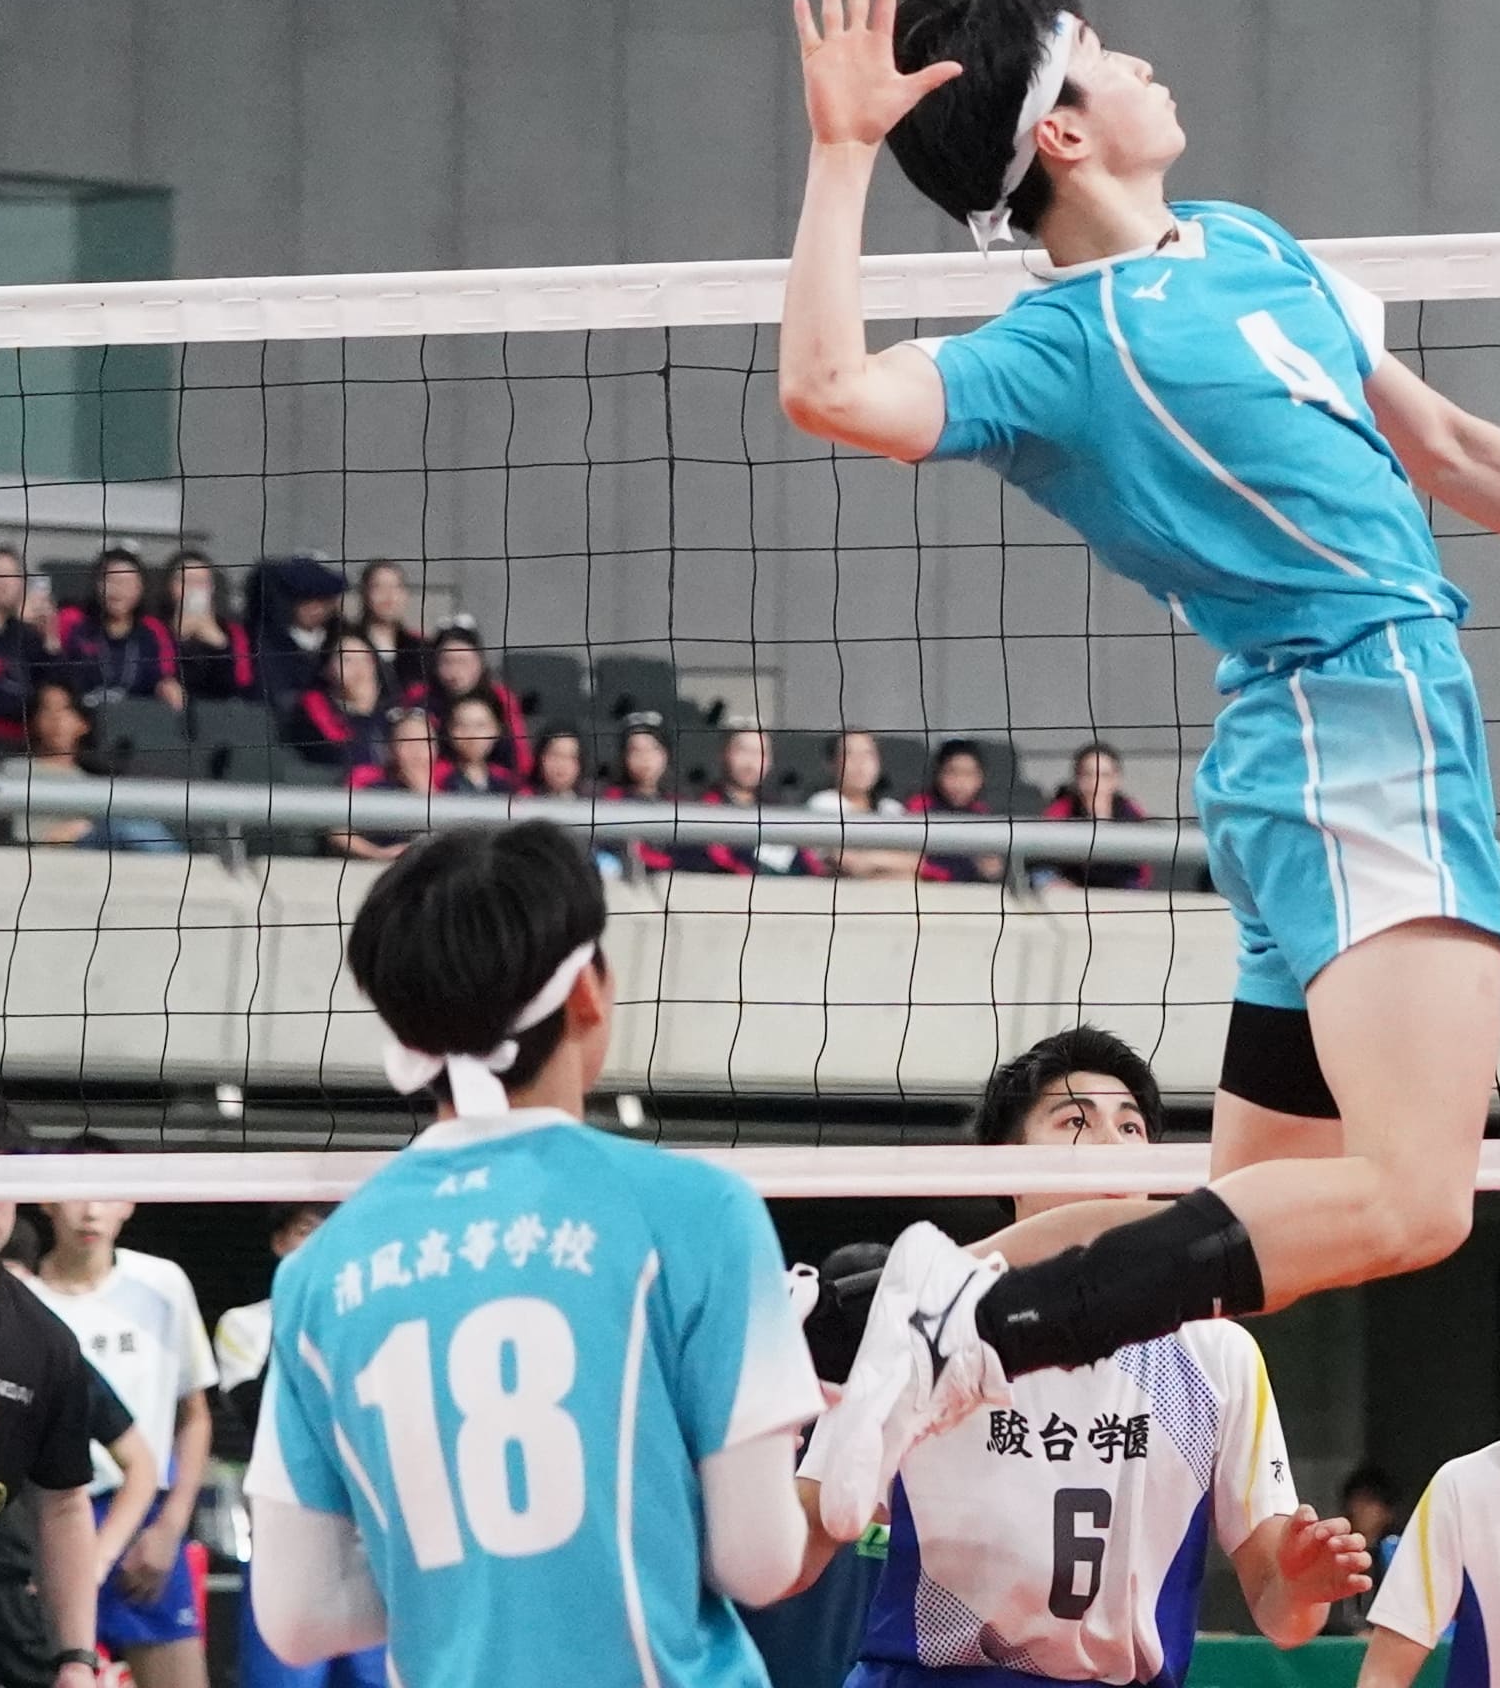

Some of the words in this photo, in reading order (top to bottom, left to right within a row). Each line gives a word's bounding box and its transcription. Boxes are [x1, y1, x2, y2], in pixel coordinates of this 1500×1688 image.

[334, 1212, 598, 1316] 清風高等学校
[355, 1295, 586, 1572] 18
[986, 1408, 1151, 1464] 駿台学園
[1048, 1488, 1113, 1620] 6
